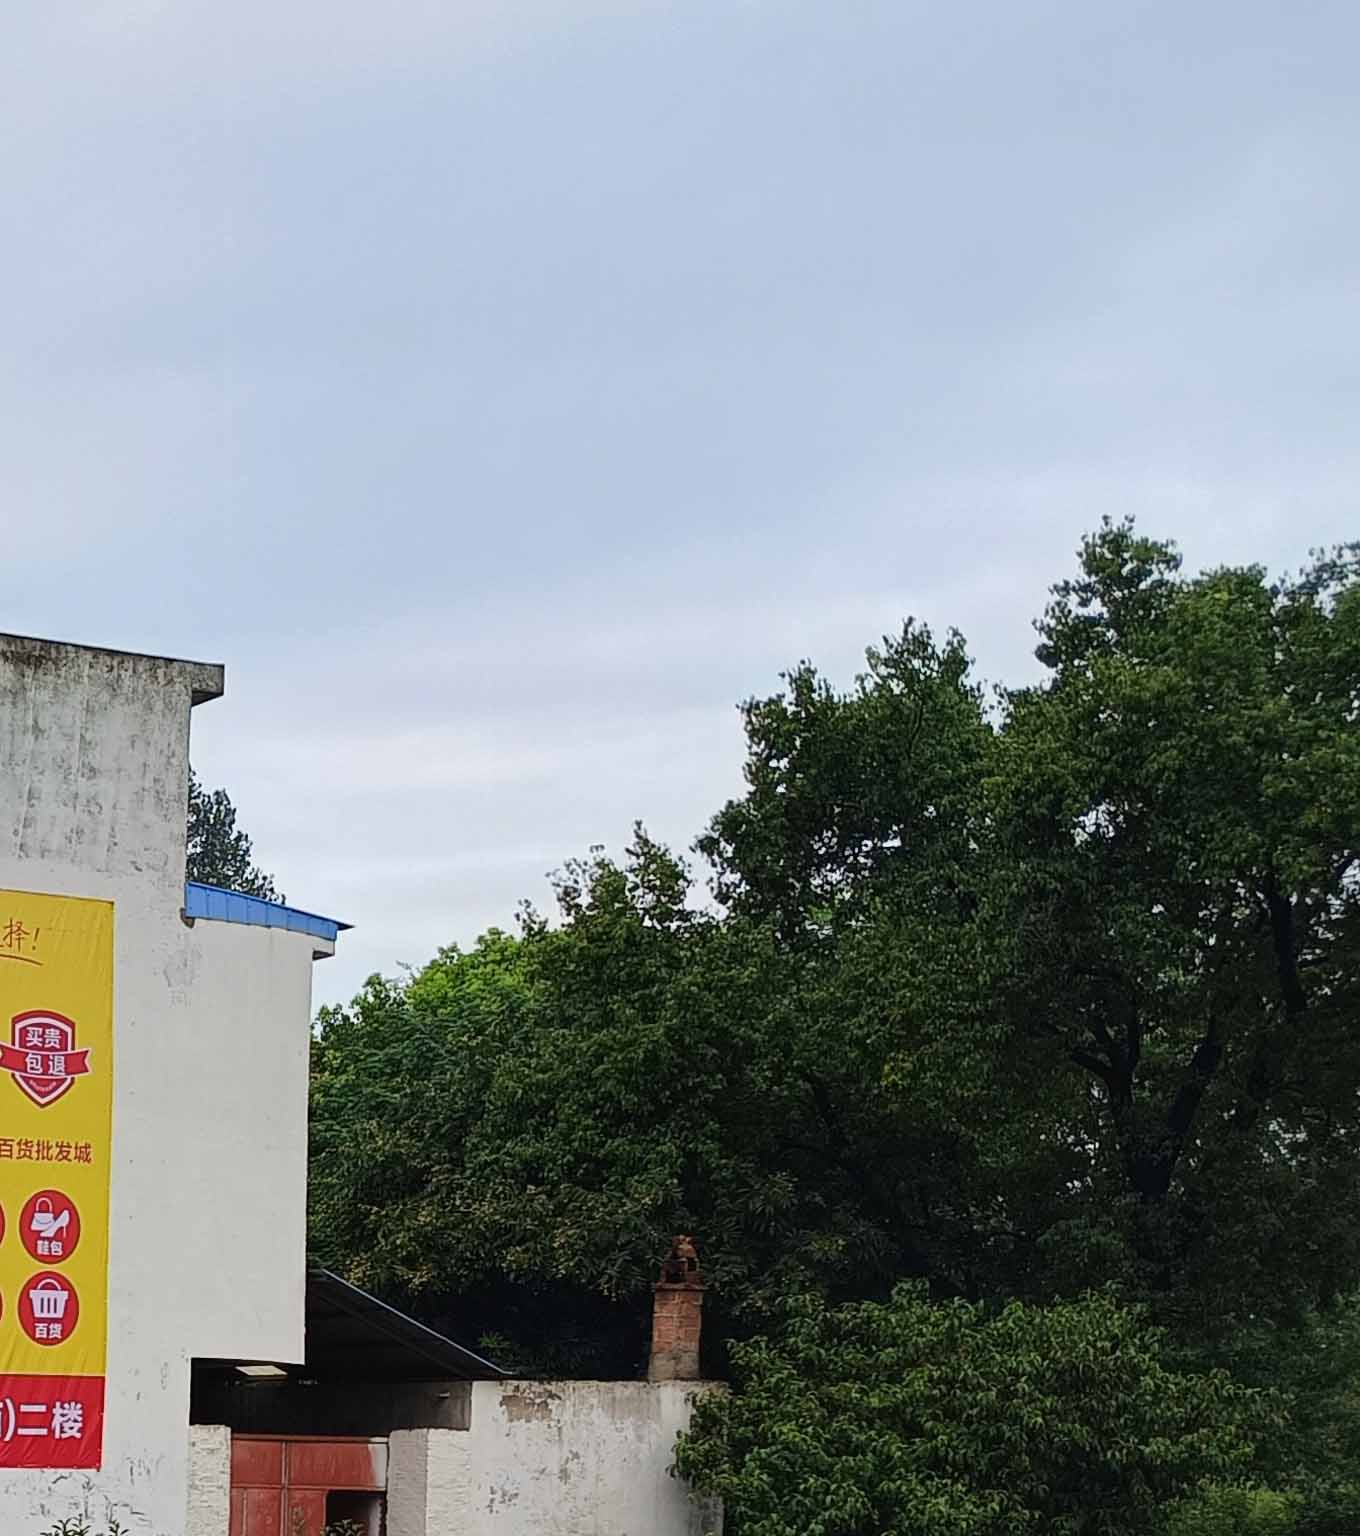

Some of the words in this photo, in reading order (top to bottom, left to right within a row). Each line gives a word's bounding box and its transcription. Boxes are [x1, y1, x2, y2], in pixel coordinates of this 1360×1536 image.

[25, 1026, 63, 1049] 买贵
[25, 1053, 66, 1076] 包退
[36, 1239, 63, 1256] 鞋包
[34, 1323, 62, 1339] 百货
